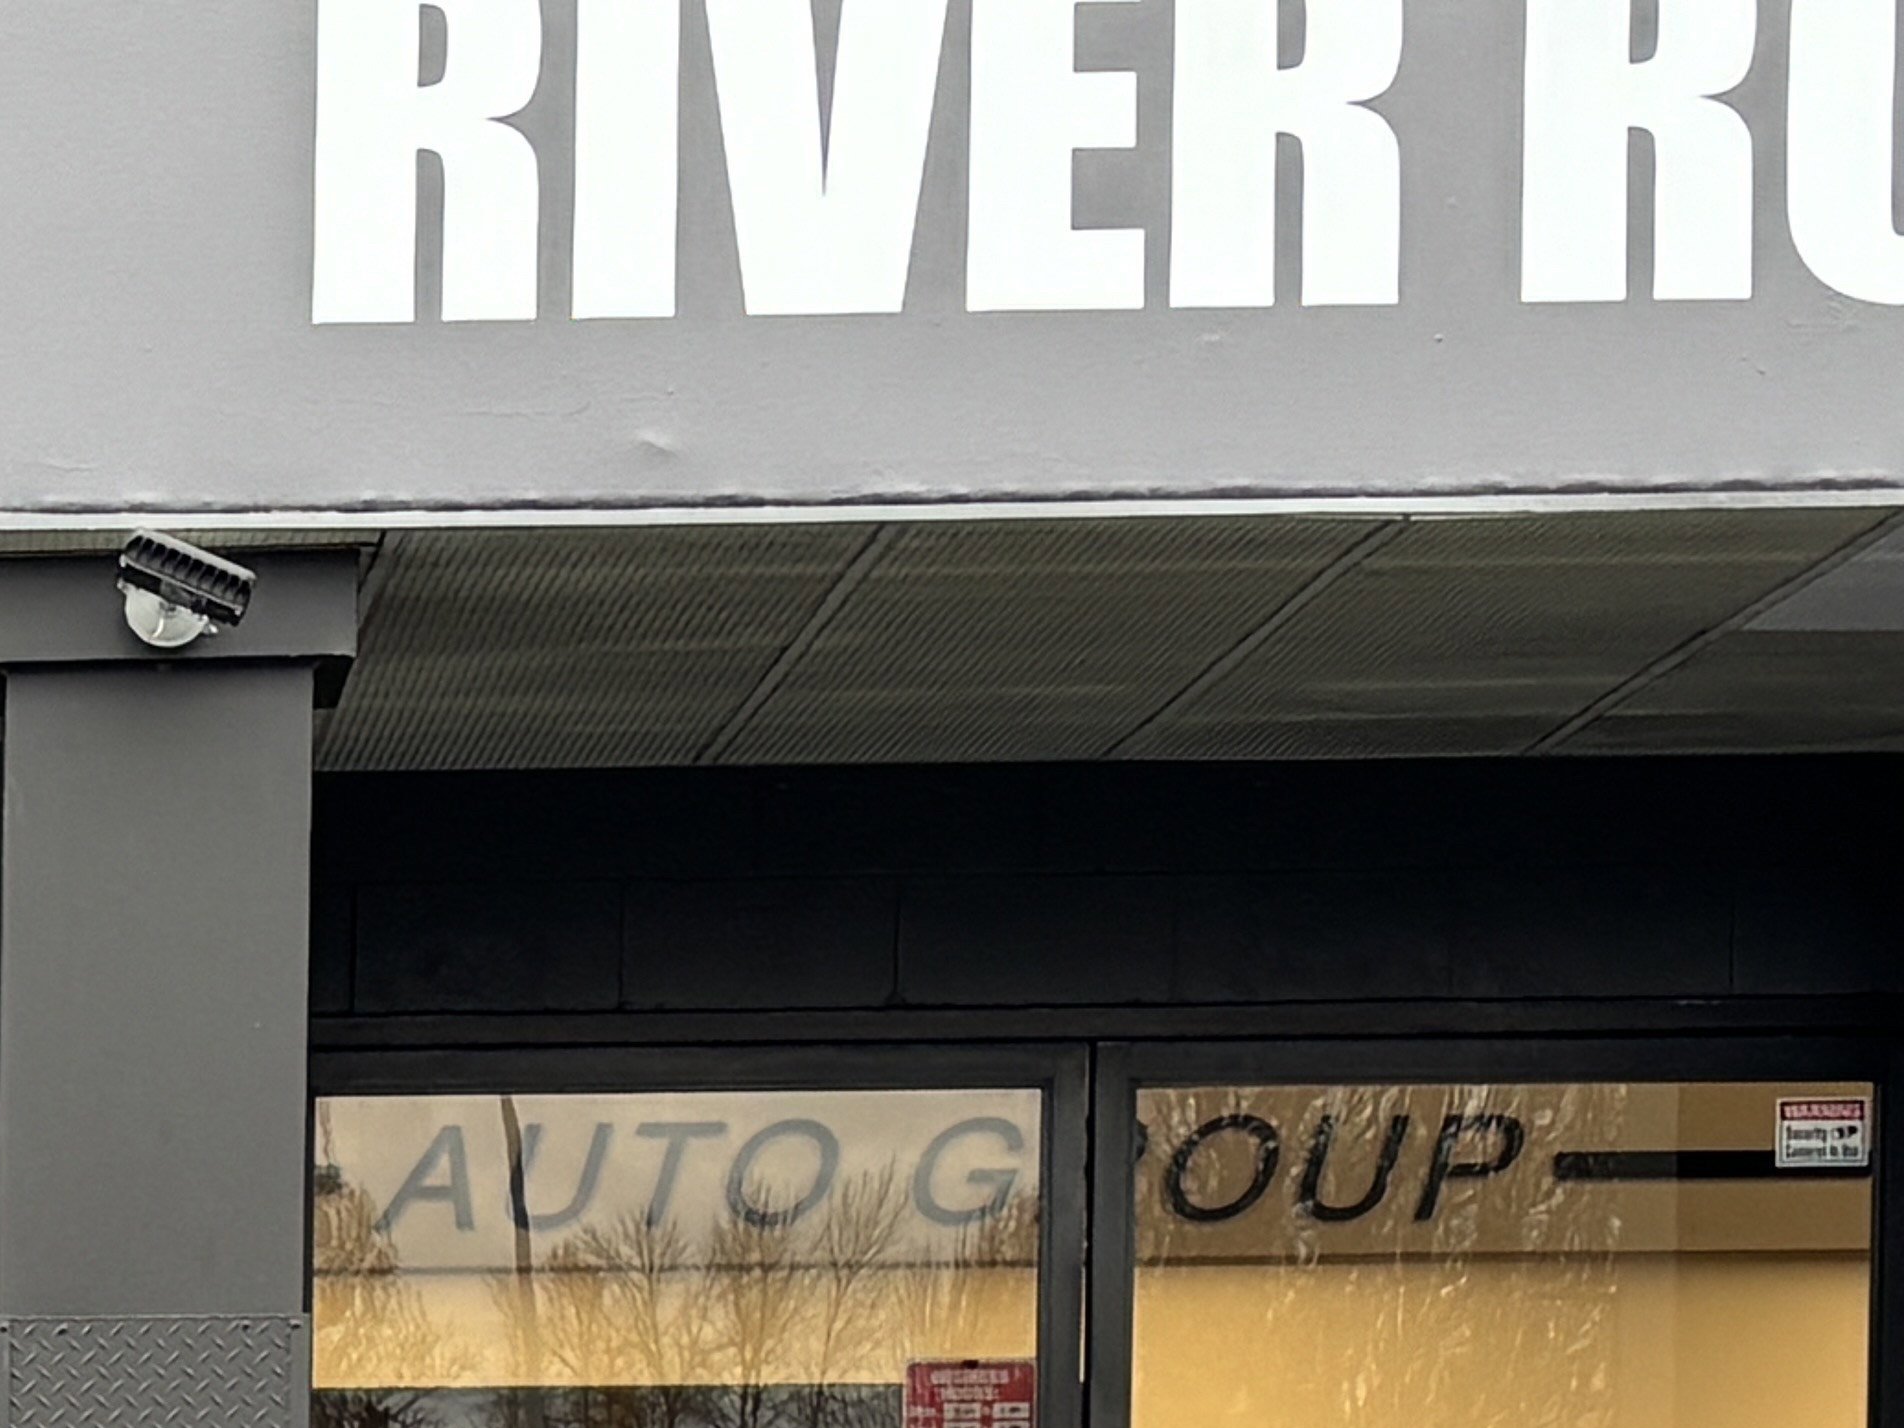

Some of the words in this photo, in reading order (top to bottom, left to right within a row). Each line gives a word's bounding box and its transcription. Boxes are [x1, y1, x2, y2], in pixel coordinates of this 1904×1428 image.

[311, 0, 1400, 325] RIVER
[372, 1117, 840, 1233] AUTO
[912, 1114, 1524, 1223] GOUP
